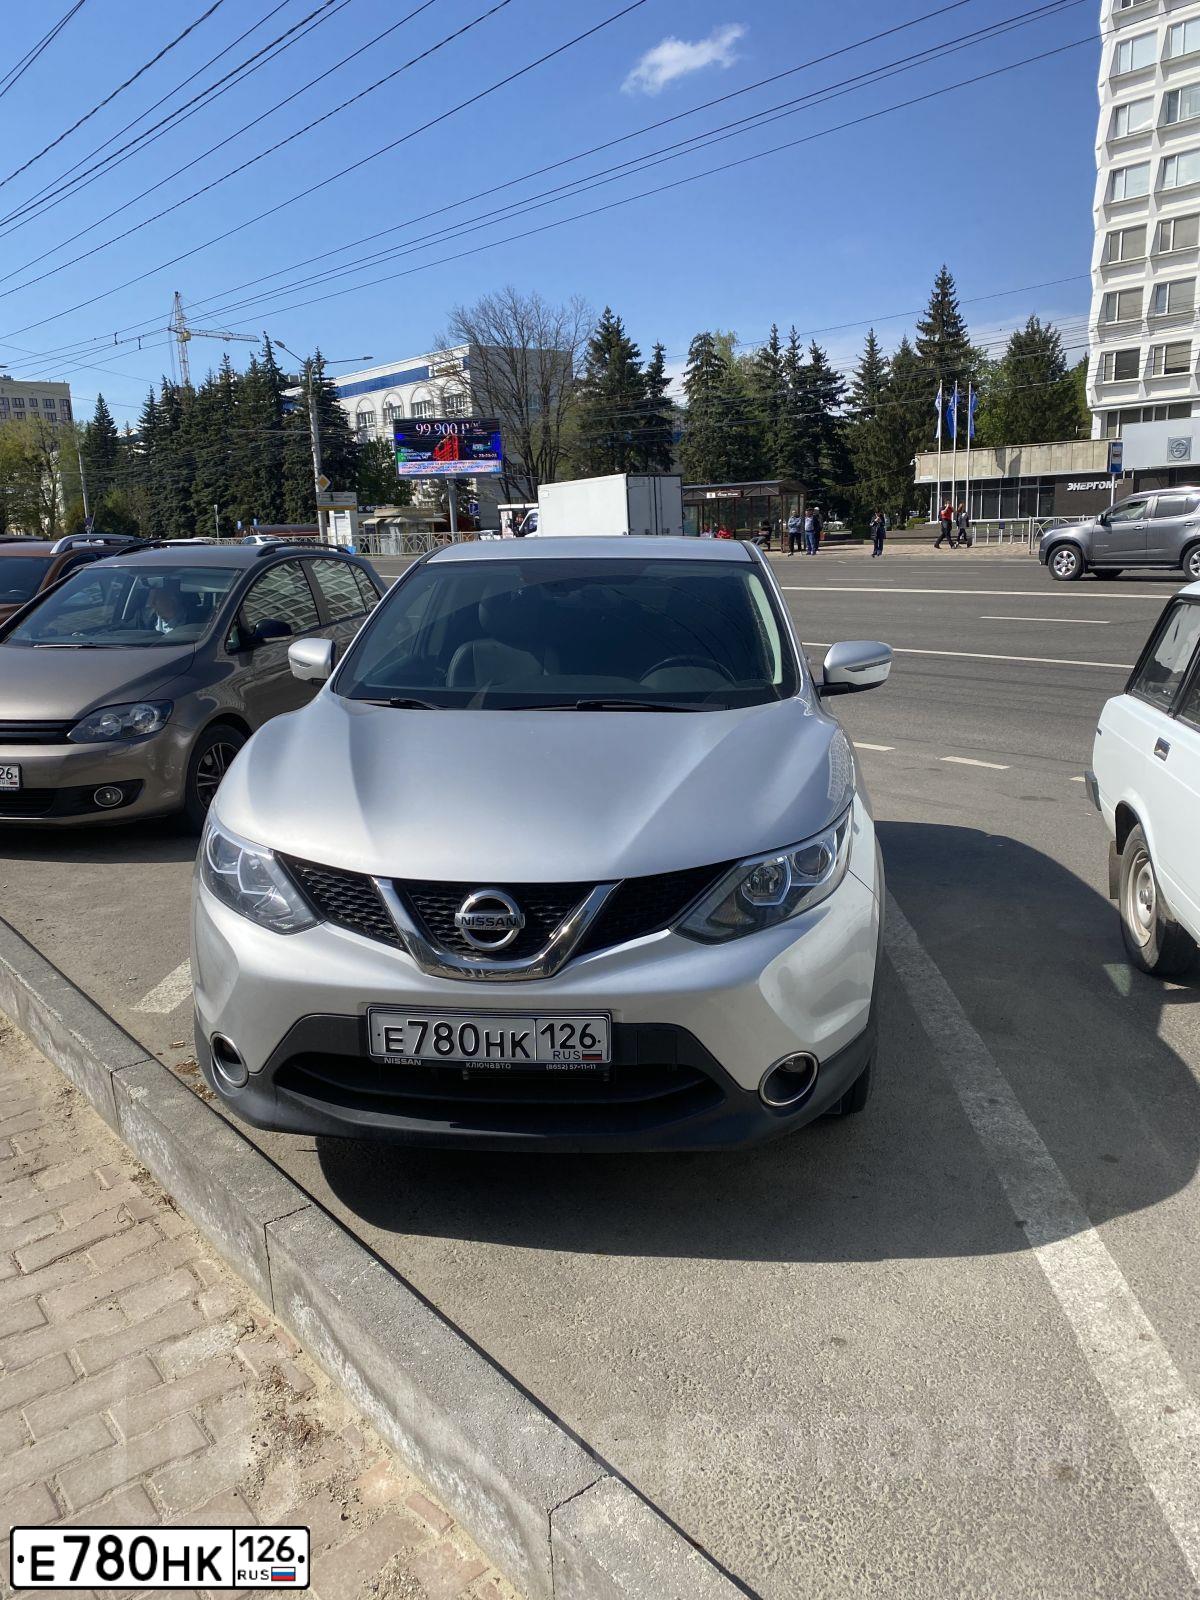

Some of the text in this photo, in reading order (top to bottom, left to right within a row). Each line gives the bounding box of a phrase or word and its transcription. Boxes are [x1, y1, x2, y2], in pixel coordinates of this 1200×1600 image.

[415, 423, 431, 435] 99
[434, 422, 458, 435] 900
[460, 916, 518, 927] NISSAN
[539, 1022, 597, 1050] 126
[552, 1050, 581, 1060] RUS
[383, 1057, 422, 1066] NISSAN
[545, 1063, 568, 1071] (8652)
